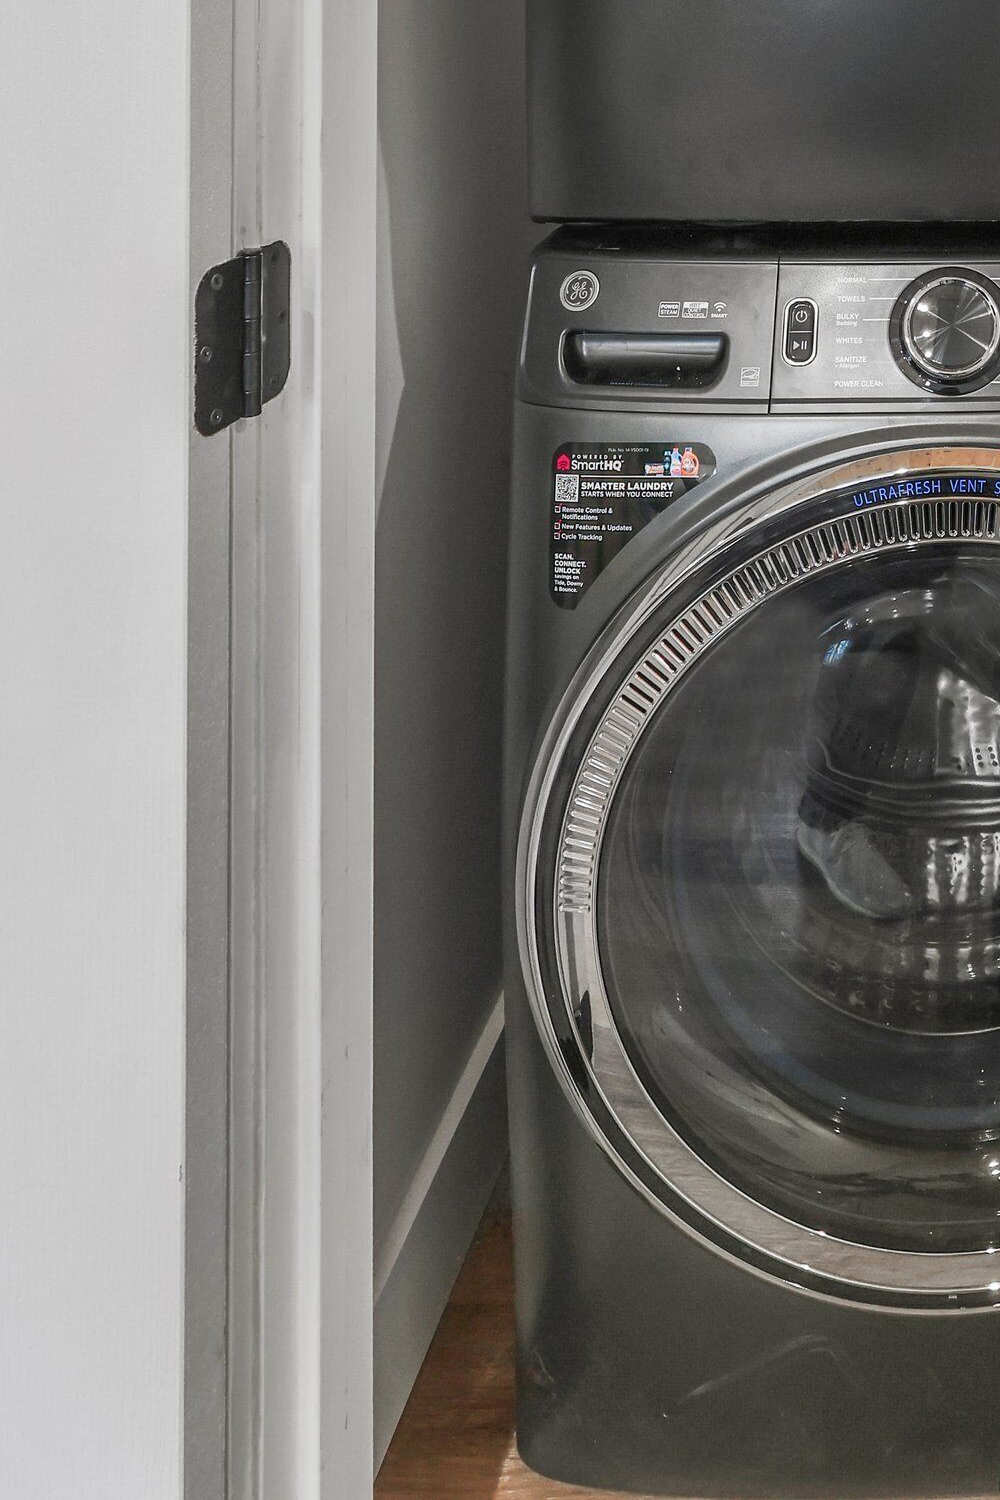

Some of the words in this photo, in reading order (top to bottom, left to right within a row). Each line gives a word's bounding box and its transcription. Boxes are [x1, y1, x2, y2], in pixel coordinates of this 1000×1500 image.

[581, 482, 625, 490] SMARTER
[627, 482, 673, 491] LAUNDRY
[853, 480, 941, 507] ULTRAFRESH
[950, 479, 986, 493] VENT
[607, 524, 632, 532] Updates
[554, 560, 587, 568] CONNECT.
